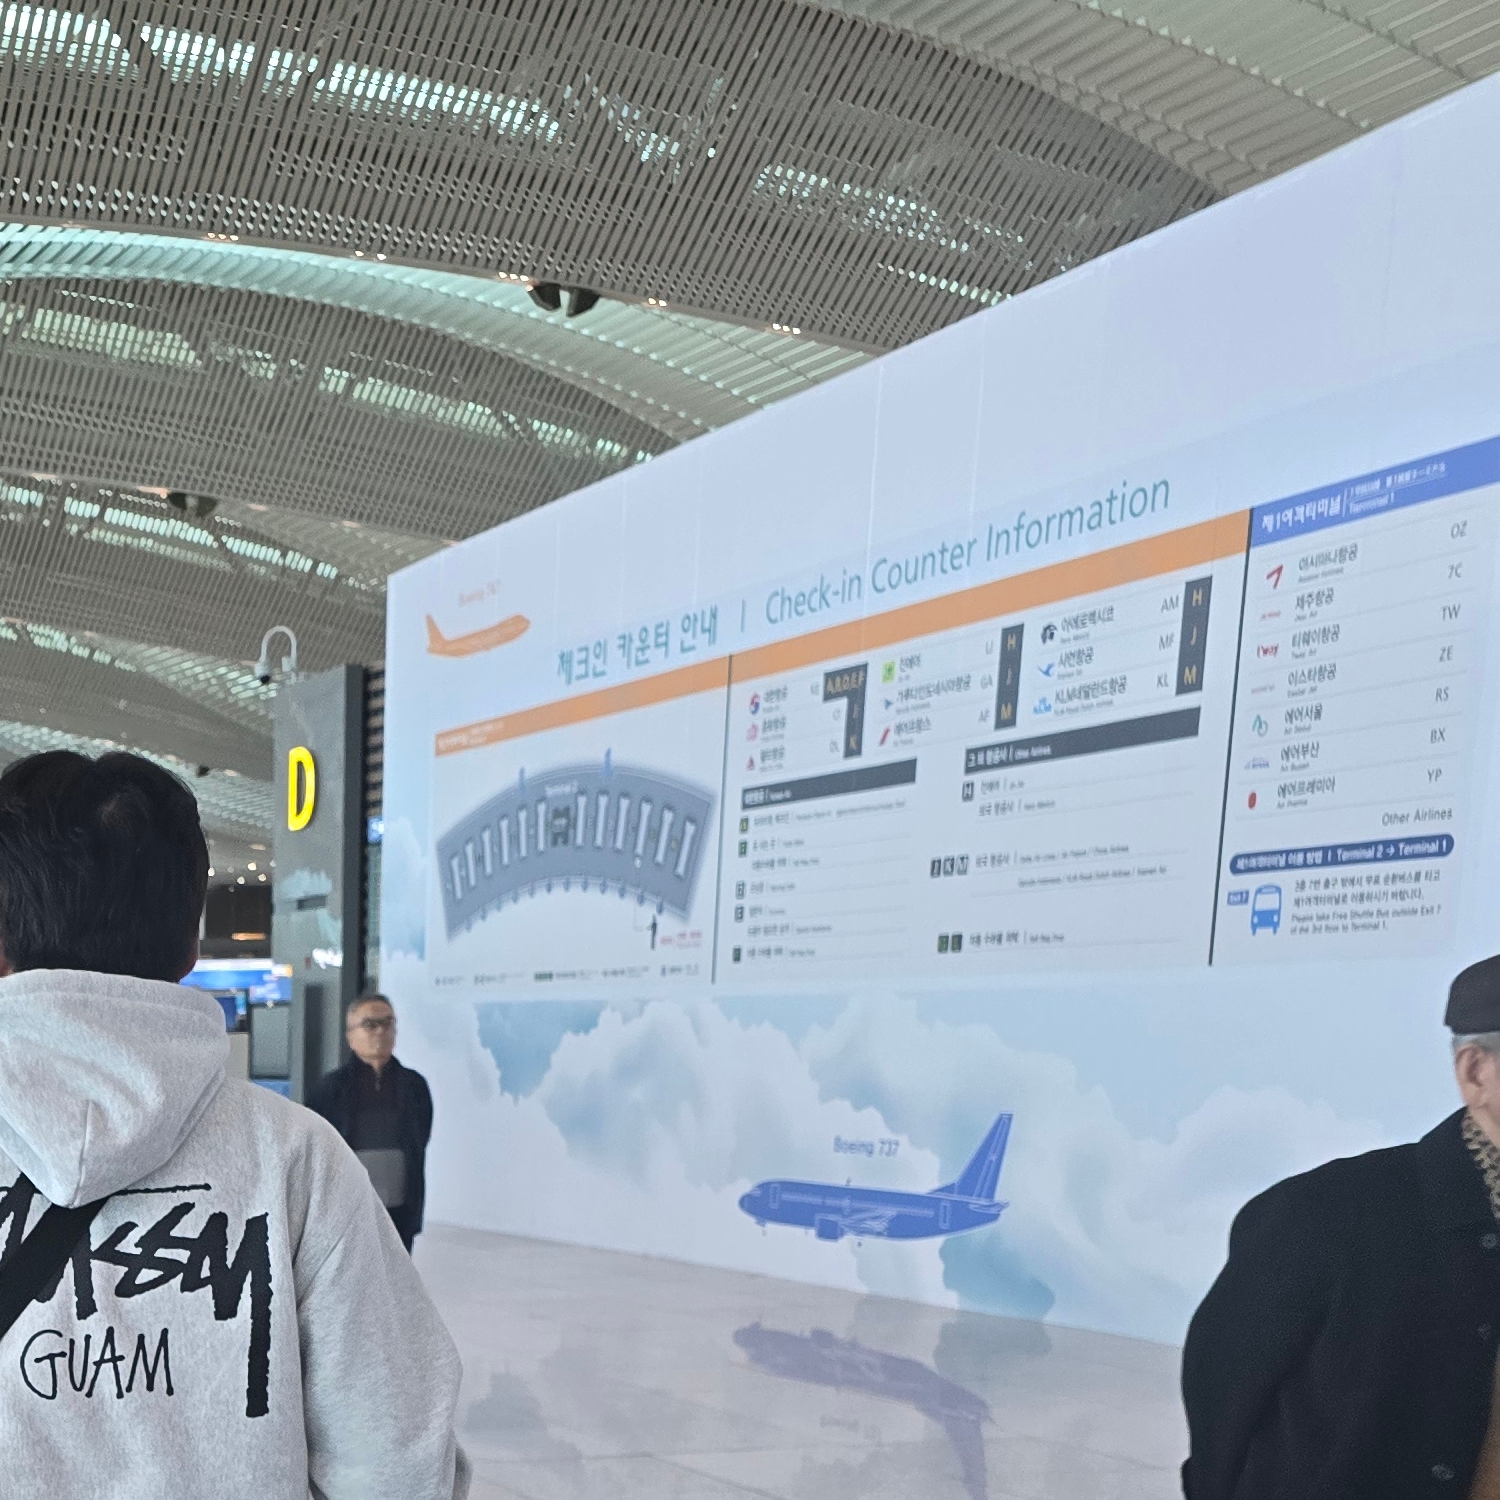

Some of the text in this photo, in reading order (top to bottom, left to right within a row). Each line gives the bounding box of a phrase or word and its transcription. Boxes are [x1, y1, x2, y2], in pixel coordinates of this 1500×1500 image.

[1450, 520, 1468, 539] OZ
[765, 478, 1171, 626] Check-in Counter Information
[1160, 594, 1180, 614] AM
[1191, 586, 1203, 607] H
[1441, 603, 1462, 622] TW
[557, 604, 719, 685] 체크인 카운터 안내
[1007, 633, 1017, 651] H
[1158, 632, 1176, 651] MF
[1439, 645, 1454, 662] ZE
[1156, 672, 1169, 688] KL
[1183, 664, 1197, 686] M
[1287, 662, 1337, 687] 이스타항공
[1435, 686, 1450, 703] RS
[1000, 702, 1013, 721] M
[1284, 703, 1323, 725] 에어서울
[1280, 740, 1320, 762] 에어부산
[1427, 768, 1443, 784] YP
[287, 746, 316, 832] D
[1381, 807, 1453, 827] Other Airlines
[1337, 839, 1448, 862] Terminal 2 Terminal 1
[833, 1135, 875, 1157] Boeing
[20, 1326, 175, 1400] GUAM
